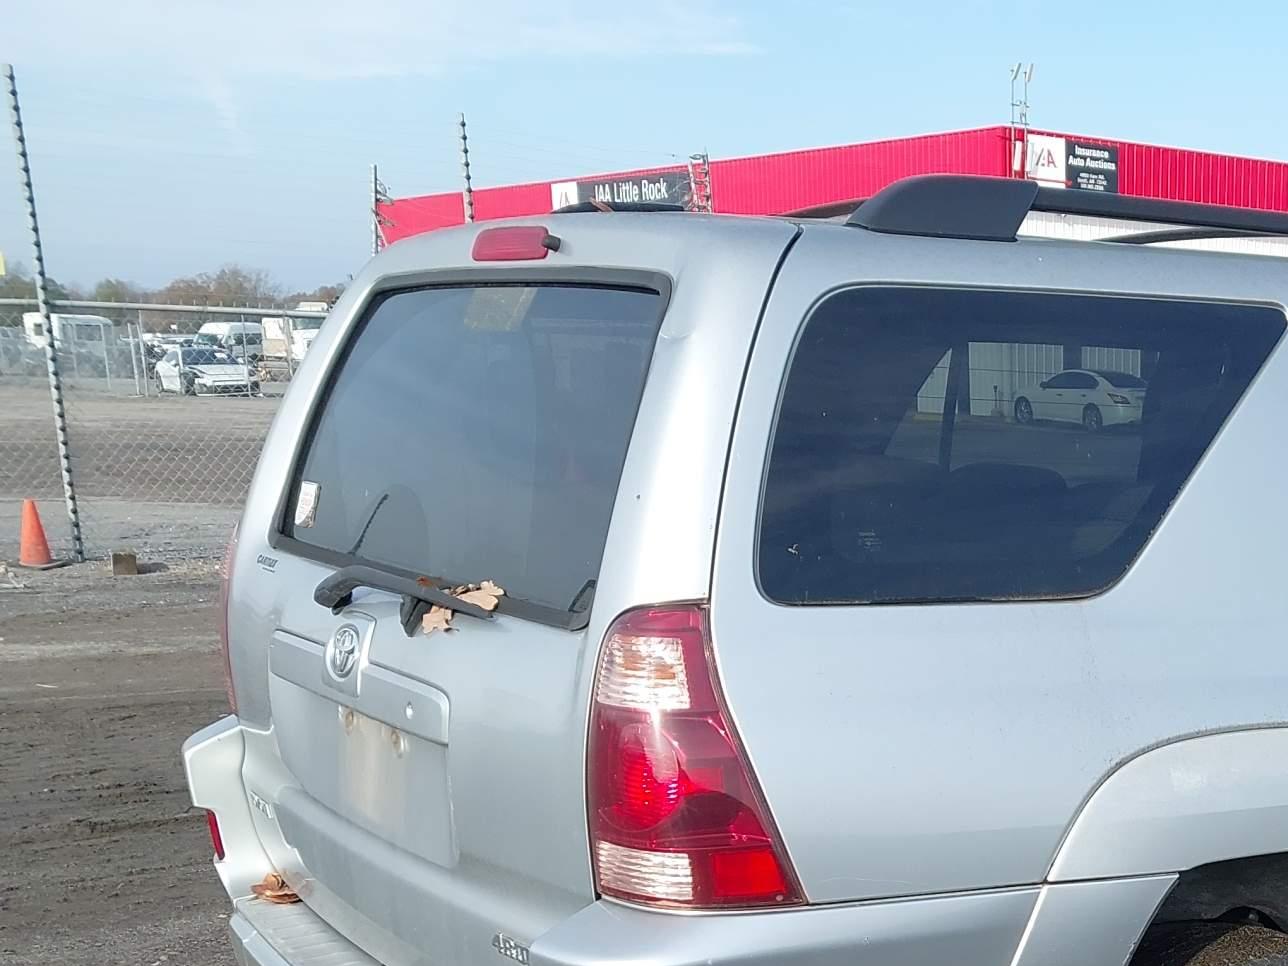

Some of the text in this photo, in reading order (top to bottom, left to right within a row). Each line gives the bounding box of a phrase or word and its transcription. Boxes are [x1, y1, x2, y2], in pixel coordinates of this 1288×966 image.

[1075, 144, 1109, 159] Insurance
[1068, 155, 1116, 170] Auto Auctions
[594, 178, 668, 203] IAA Little Rock
